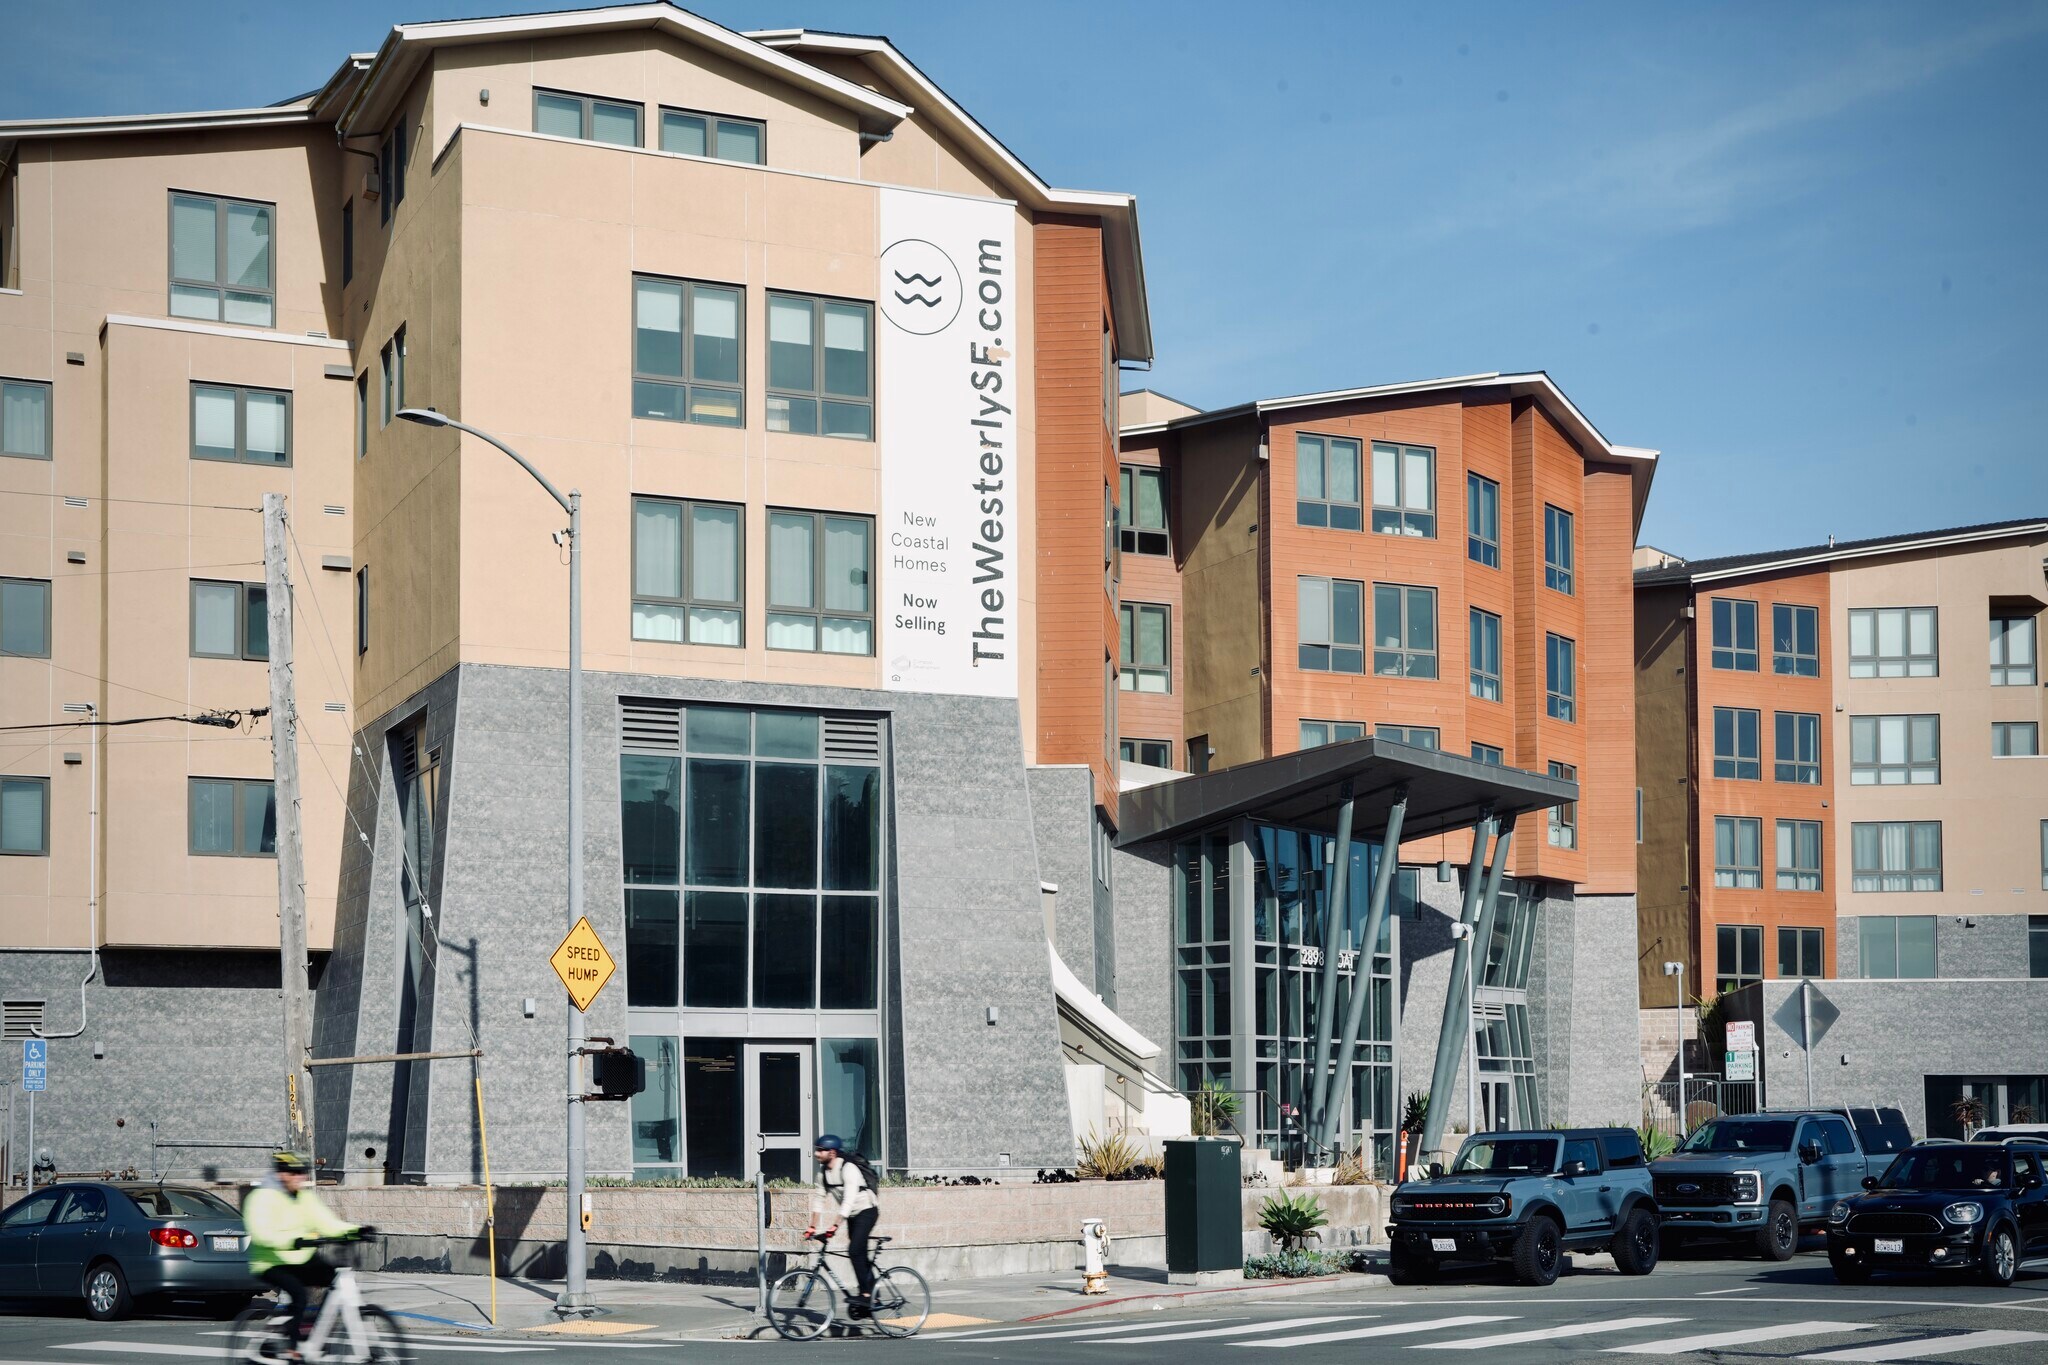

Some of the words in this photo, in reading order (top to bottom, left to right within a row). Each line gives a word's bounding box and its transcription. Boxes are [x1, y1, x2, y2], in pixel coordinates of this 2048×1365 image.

[970, 239, 1012, 668] TheWesterlySF.com
[903, 511, 937, 528] New
[891, 532, 949, 551] Coastal
[894, 555, 947, 573] Homes
[903, 593, 938, 609] Now
[894, 614, 946, 636] Selling
[567, 945, 601, 961] SPEED
[1301, 949, 1324, 966] 2898
[568, 967, 599, 981] HUMP
[24, 1061, 46, 1069] PARKING
[28, 1069, 42, 1077] ONLY
